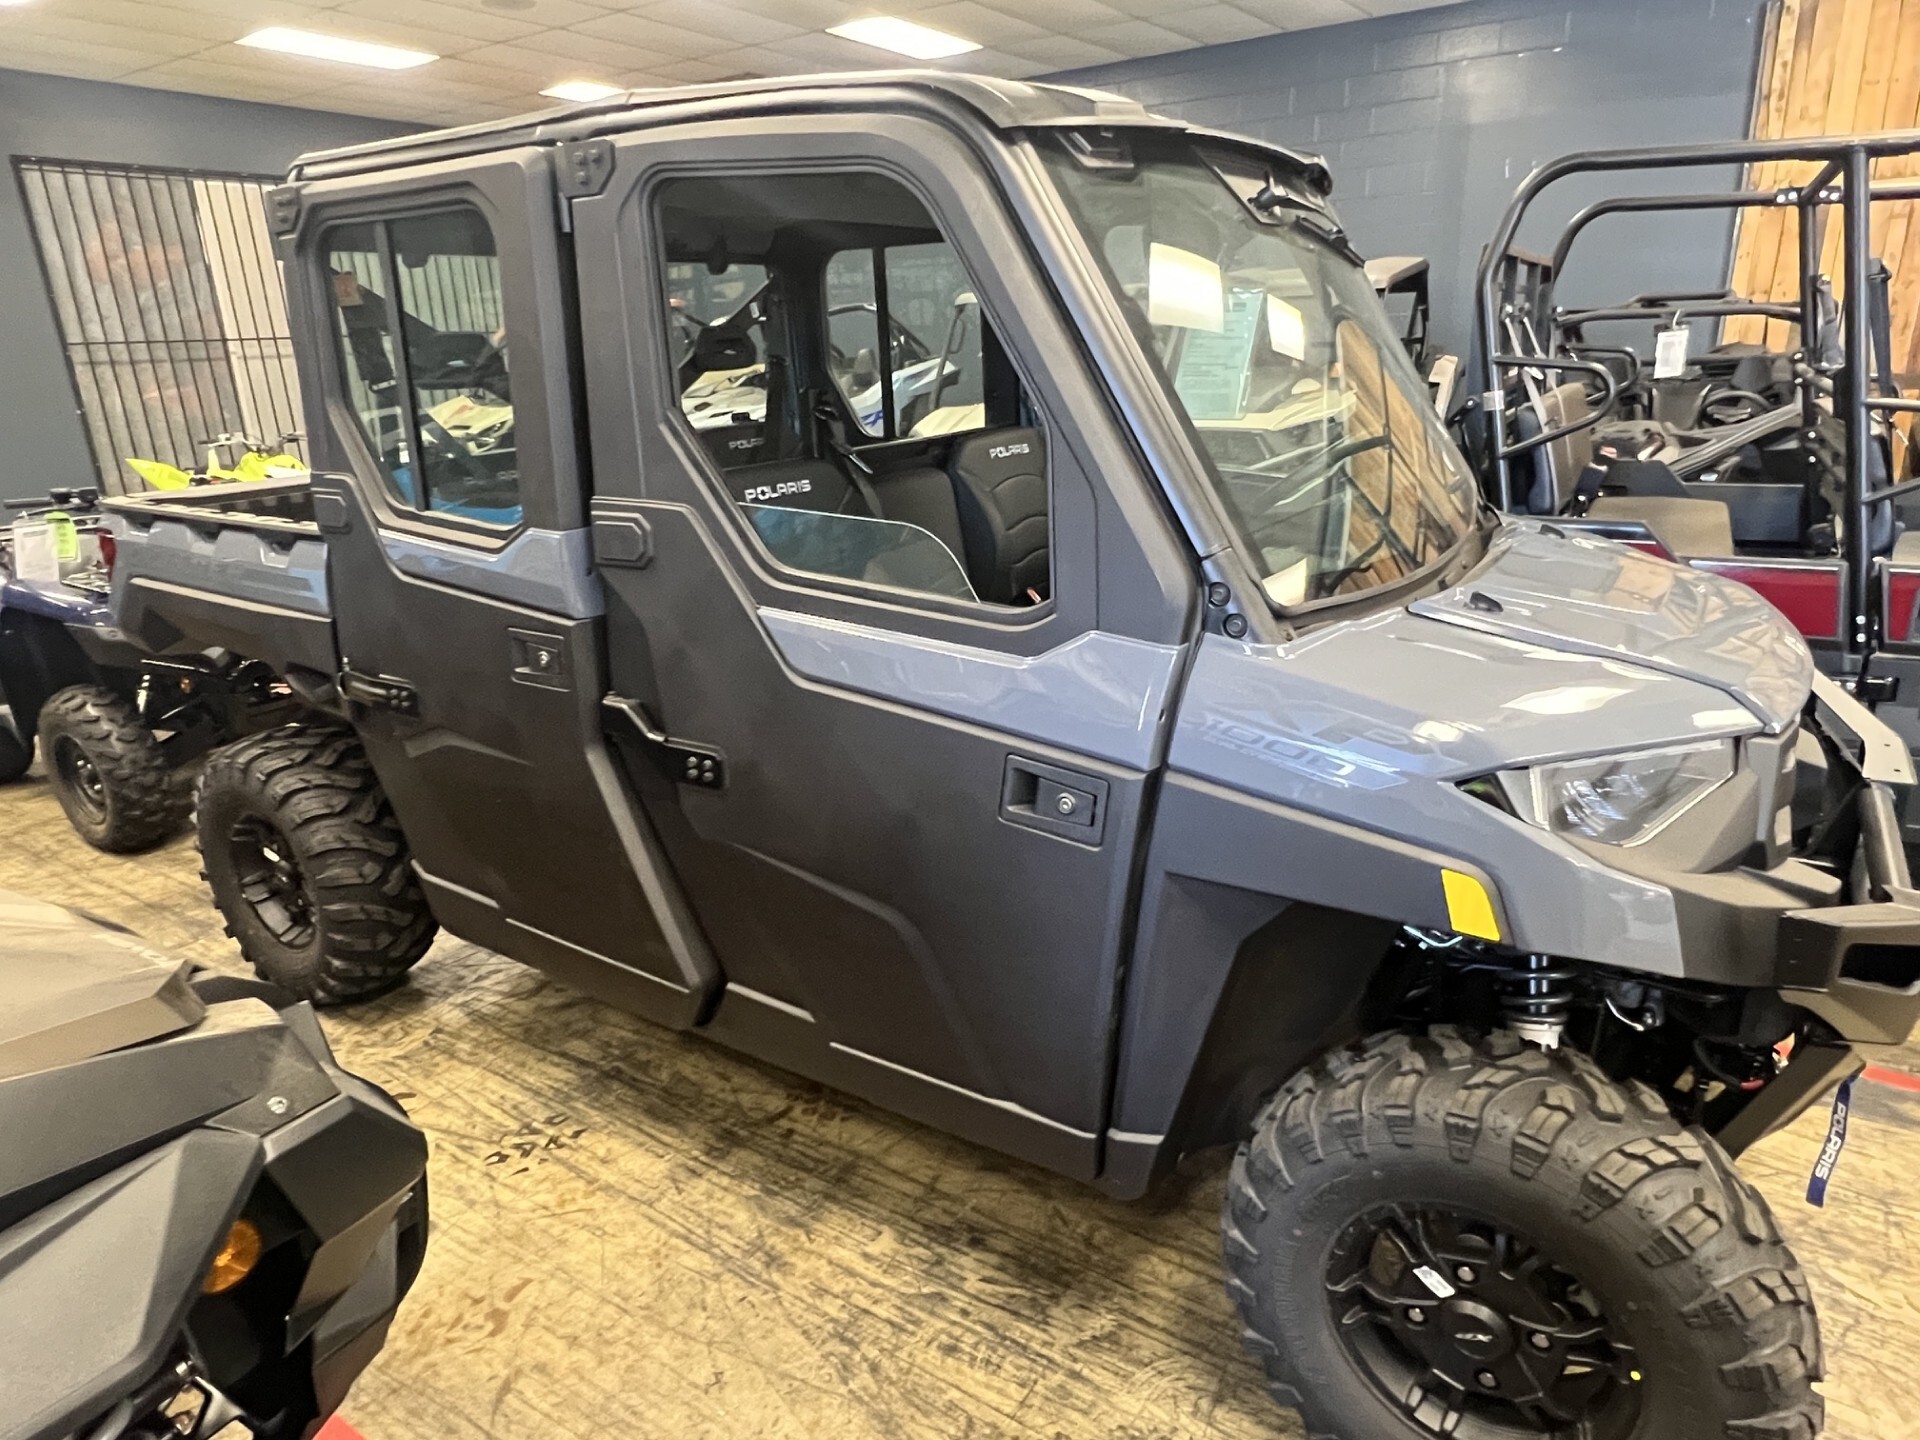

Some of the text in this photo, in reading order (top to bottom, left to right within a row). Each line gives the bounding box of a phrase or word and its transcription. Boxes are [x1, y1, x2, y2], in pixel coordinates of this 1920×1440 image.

[988, 443, 1030, 459] POLARIS
[743, 479, 812, 502] POLARIS
[1814, 1101, 1847, 1180] POLARIS
